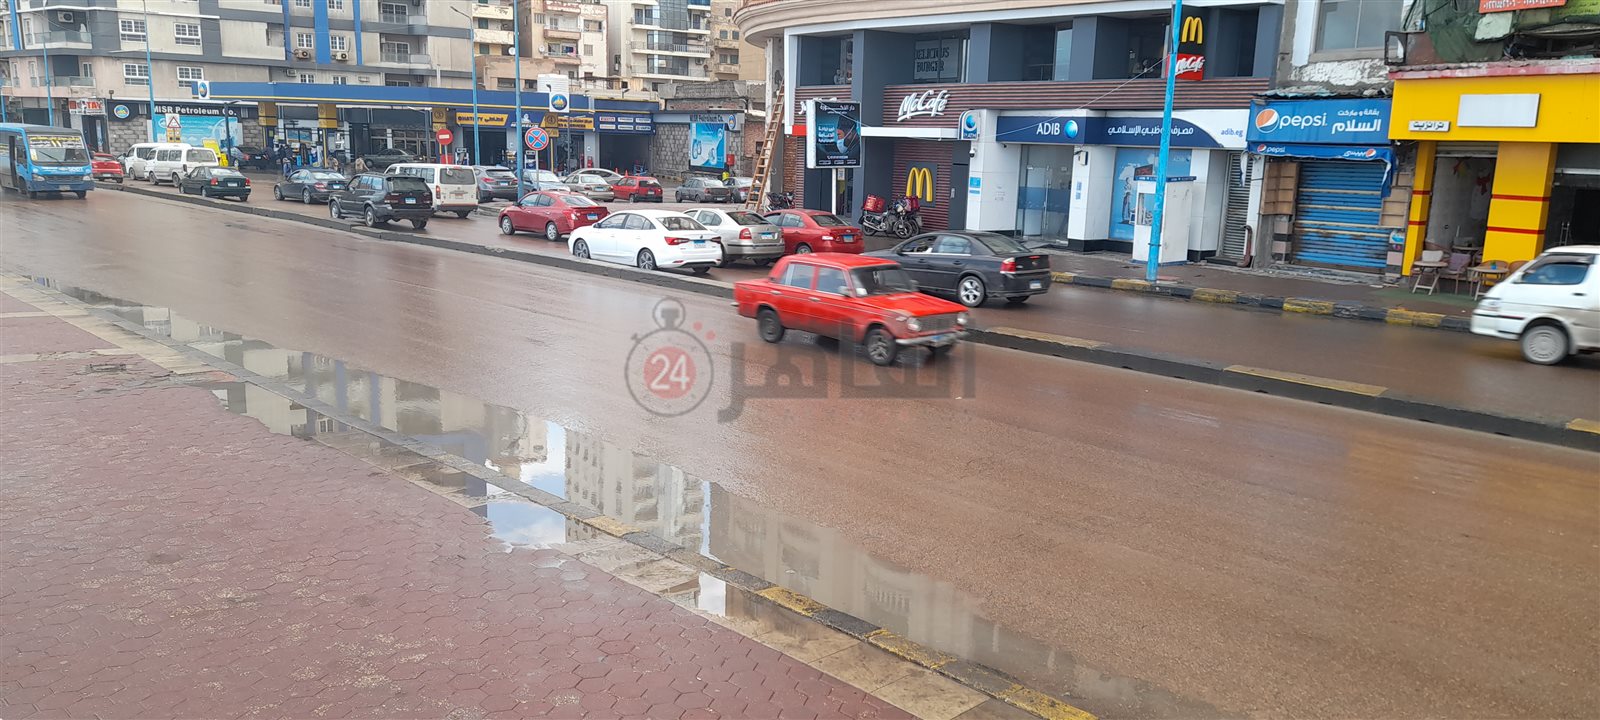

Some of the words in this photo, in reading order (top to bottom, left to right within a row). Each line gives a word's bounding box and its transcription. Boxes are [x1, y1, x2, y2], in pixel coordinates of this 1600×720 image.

[175, 106, 219, 115] Petroleum
[897, 89, 950, 121] McCafé
[1279, 113, 1326, 129] pepsi
[1332, 118, 1381, 134] السلام
[1036, 123, 1060, 135] ADIB
[1108, 125, 1141, 136] الإسلامي
[1170, 126, 1193, 136] مصرف
[1220, 128, 1243, 137] adib.eg
